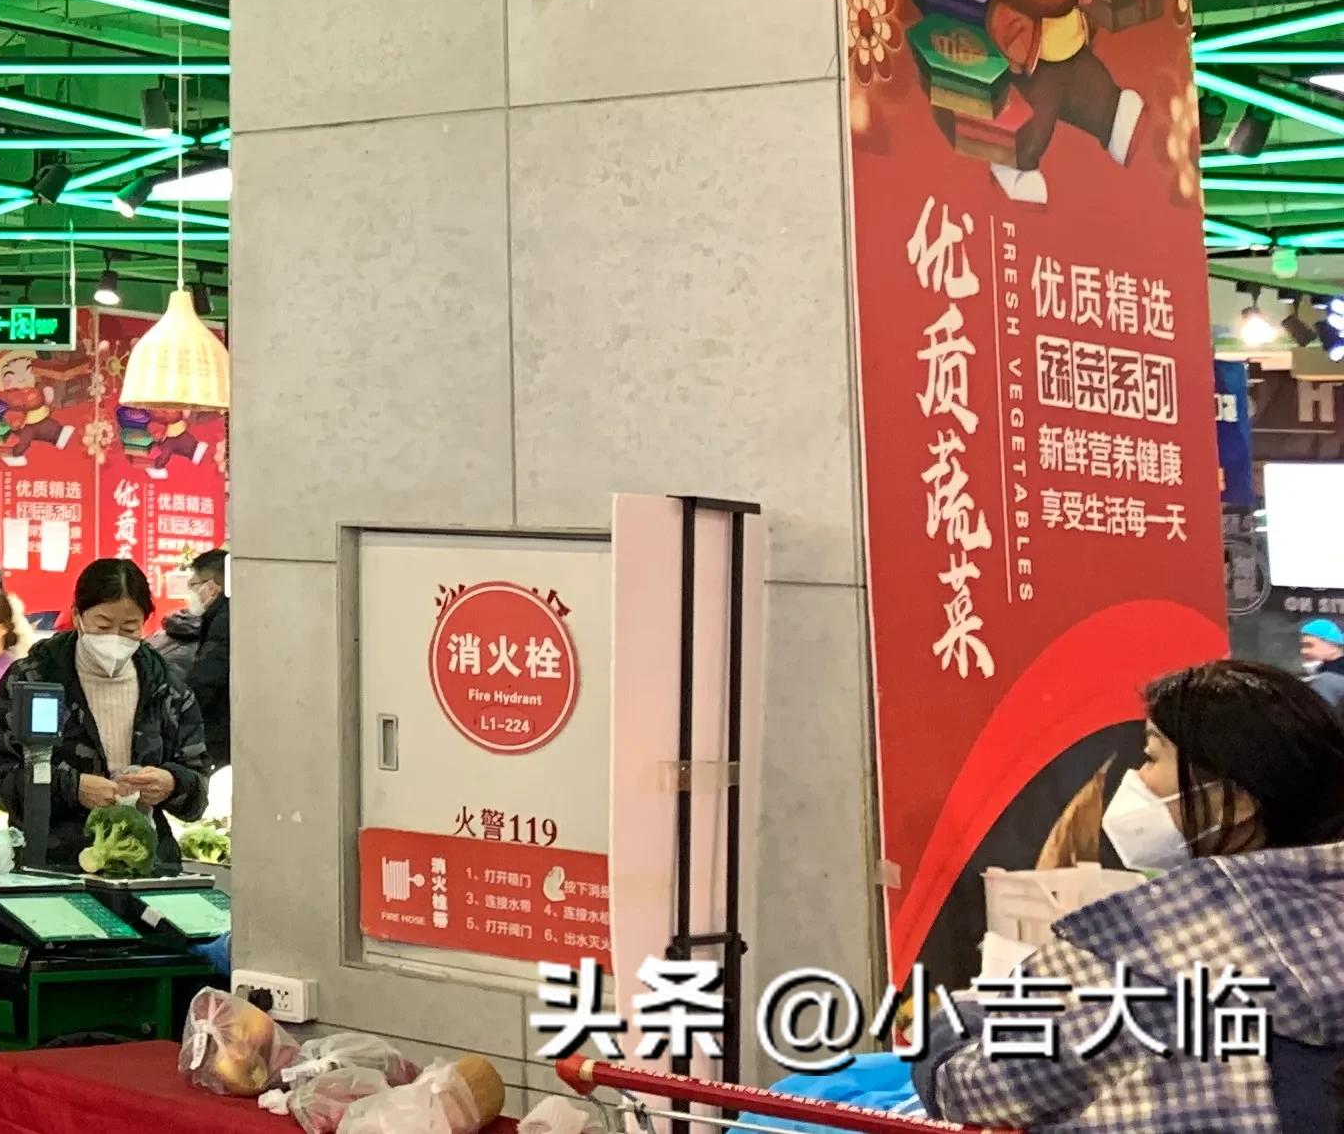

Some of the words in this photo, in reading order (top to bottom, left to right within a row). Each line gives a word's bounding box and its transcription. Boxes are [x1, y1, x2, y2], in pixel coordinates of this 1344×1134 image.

[1001, 220, 1020, 336] FRESH
[1031, 255, 1176, 341] 优质精选
[1035, 334, 1179, 424] 蔬菜系列
[907, 195, 995, 680] 优质蔬菜
[1037, 423, 1183, 487] 新鲜营养健康
[15, 480, 82, 500] 优质精选
[158, 493, 215, 515] 优质精选
[1008, 357, 1034, 603] VEGETABLES
[1040, 487, 1188, 542] 享受生活每一天
[447, 632, 562, 681] 消火栓
[468, 688, 491, 703] Fire
[493, 690, 542, 707] Hydrant
[480, 715, 530, 734] L1-224
[453, 805, 558, 847] 火警119
[381, 911, 400, 923] FIRE
